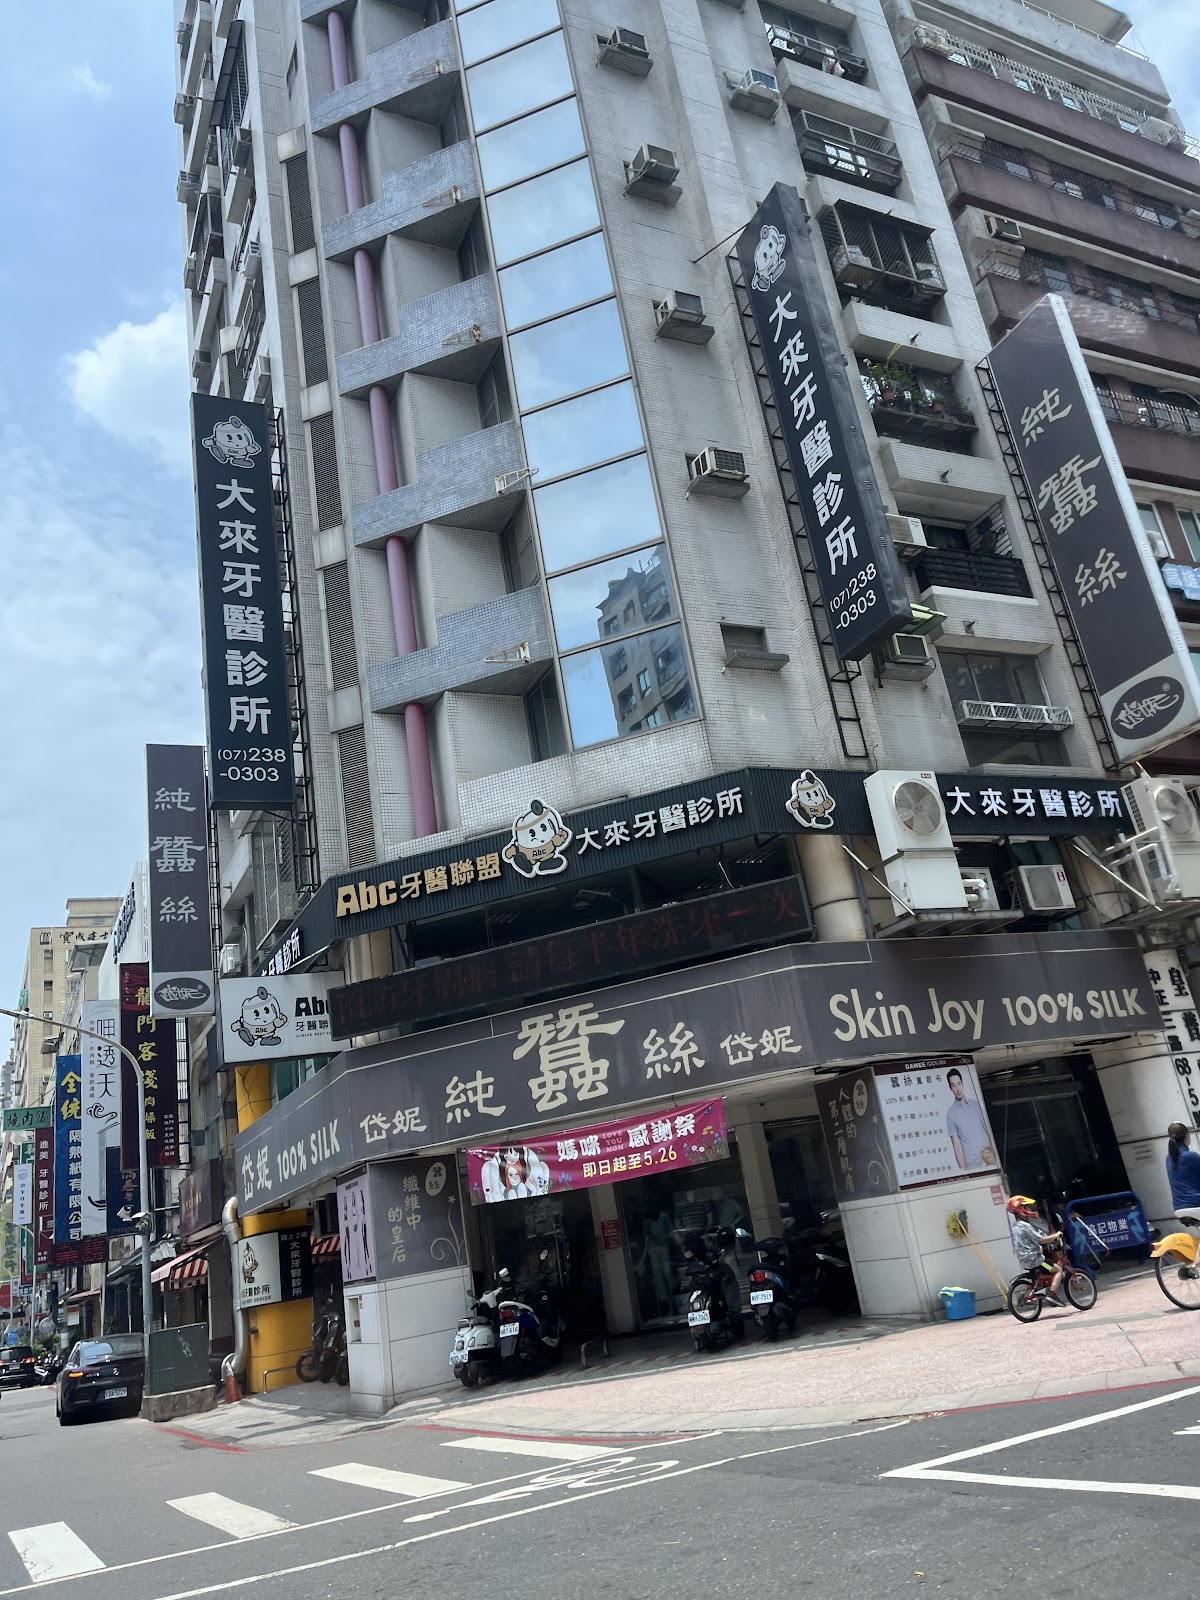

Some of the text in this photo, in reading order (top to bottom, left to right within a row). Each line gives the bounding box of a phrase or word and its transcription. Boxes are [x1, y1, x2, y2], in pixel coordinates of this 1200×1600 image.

[767, 291, 860, 576] 大來牙醫診所
[1020, 387, 1129, 607] 純蠶絲
[216, 478, 272, 735] 大來牙醫診所
[829, 563, 877, 613] (07)238
[836, 588, 877, 630] -0303
[217, 747, 287, 763] (07)238
[219, 766, 280, 782] -0303
[576, 787, 744, 856] 大來牙醫診所
[946, 786, 1123, 818] 大來牙醫診所
[151, 787, 206, 923] 純蠶絲
[532, 847, 547, 858] Abc
[336, 853, 502, 918] Abc 牙醫聯盟
[295, 996, 329, 1018] Ab
[829, 987, 1148, 1042] Skin Joy 100% SILK
[360, 1106, 427, 1145] 岱妮
[719, 1025, 803, 1064] 岱妮
[556, 1134, 601, 1163] 媽咪
[602, 1130, 623, 1139] LOVE
[605, 1137, 623, 1145] YOU
[605, 1144, 624, 1153] MOM
[627, 1113, 696, 1149] 感謝祭
[241, 1144, 273, 1203] 岱妮
[276, 1145, 308, 1184] 100%
[310, 1118, 341, 1167] SILK
[582, 1145, 677, 1179] 即日起至5.26
[39, 1169, 49, 1211] 牙醫診所
[402, 1175, 422, 1231] 纖維中
[388, 1206, 406, 1264] 的皇后
[289, 1240, 303, 1297] 大來牙醫診所
